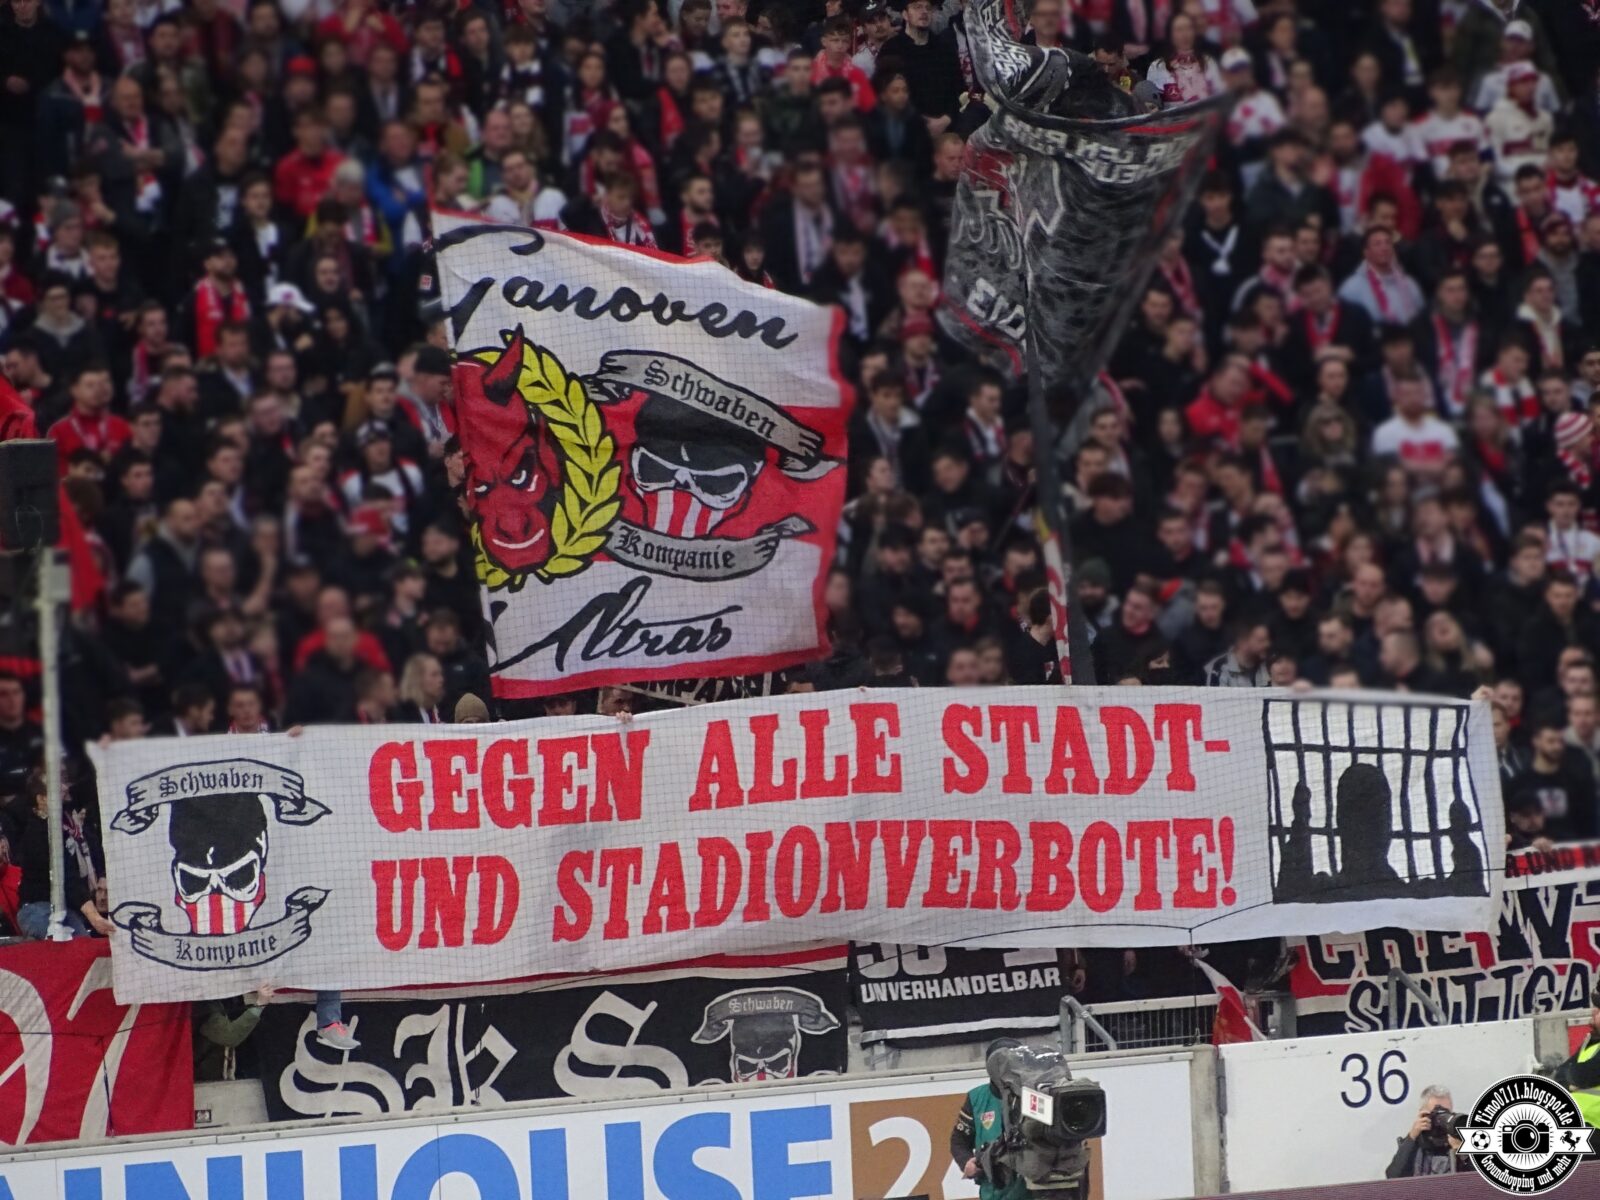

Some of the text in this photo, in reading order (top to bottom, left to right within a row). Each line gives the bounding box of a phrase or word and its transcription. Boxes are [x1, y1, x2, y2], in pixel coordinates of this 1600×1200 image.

[643, 360, 778, 439] Schwaben
[614, 524, 737, 571] Kompanie
[159, 769, 264, 798] Schwaben
[367, 702, 1230, 833] GEGEN ALLE STADT-
[371, 817, 1238, 952] UND STADIONVERBOTE!
[175, 934, 278, 966] Kompanie
[728, 996, 794, 1014] Schwaben
[860, 967, 1061, 1003] UNVERHANDELBAR
[1339, 1050, 1410, 1108] 36
